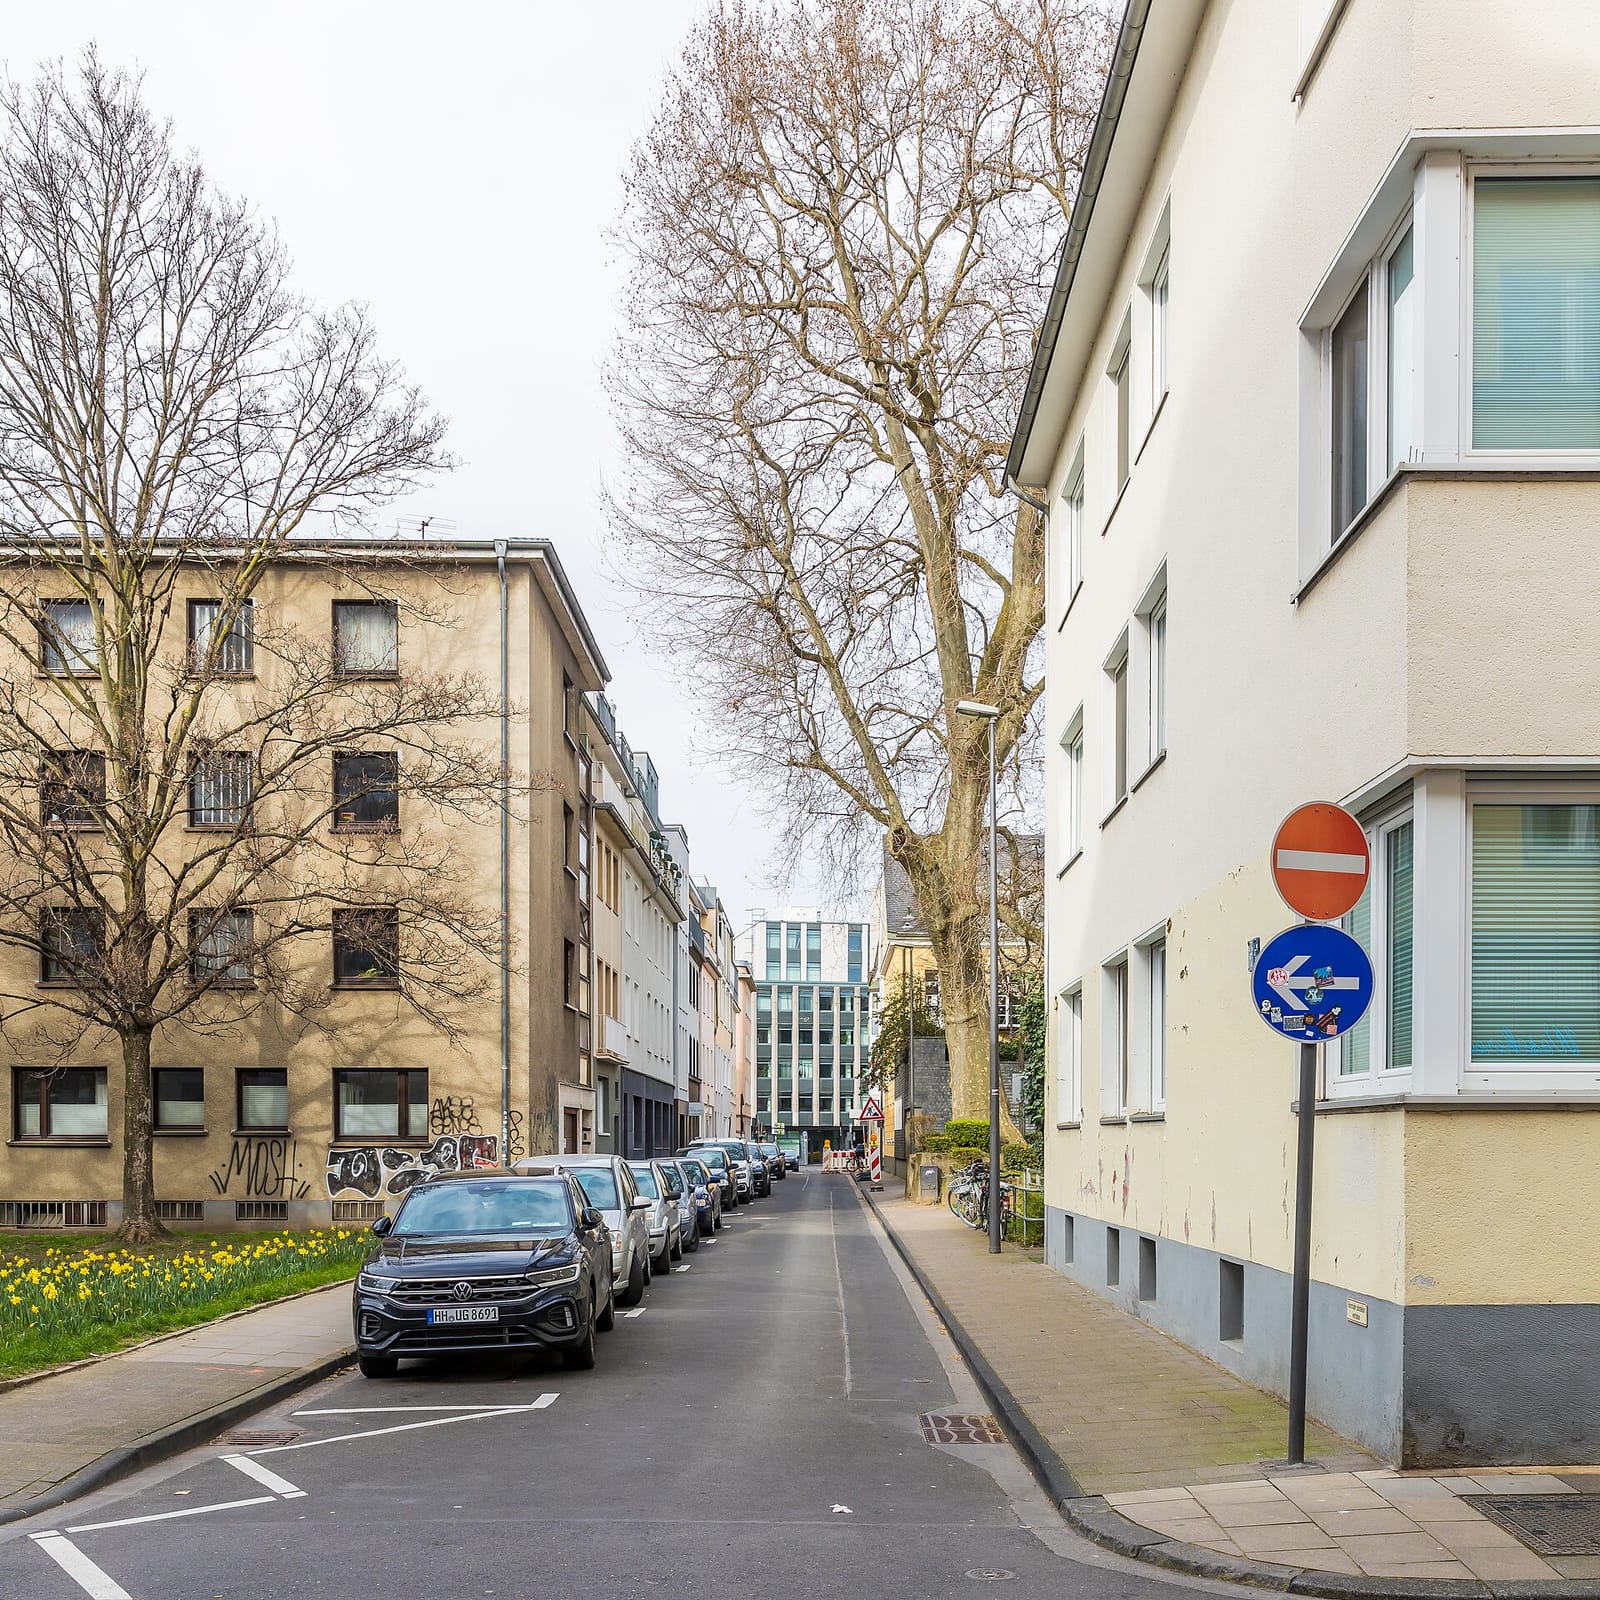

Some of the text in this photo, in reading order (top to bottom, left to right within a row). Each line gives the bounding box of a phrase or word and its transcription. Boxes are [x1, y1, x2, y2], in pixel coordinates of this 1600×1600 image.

[434, 1307, 498, 1322] HH UG 8691
